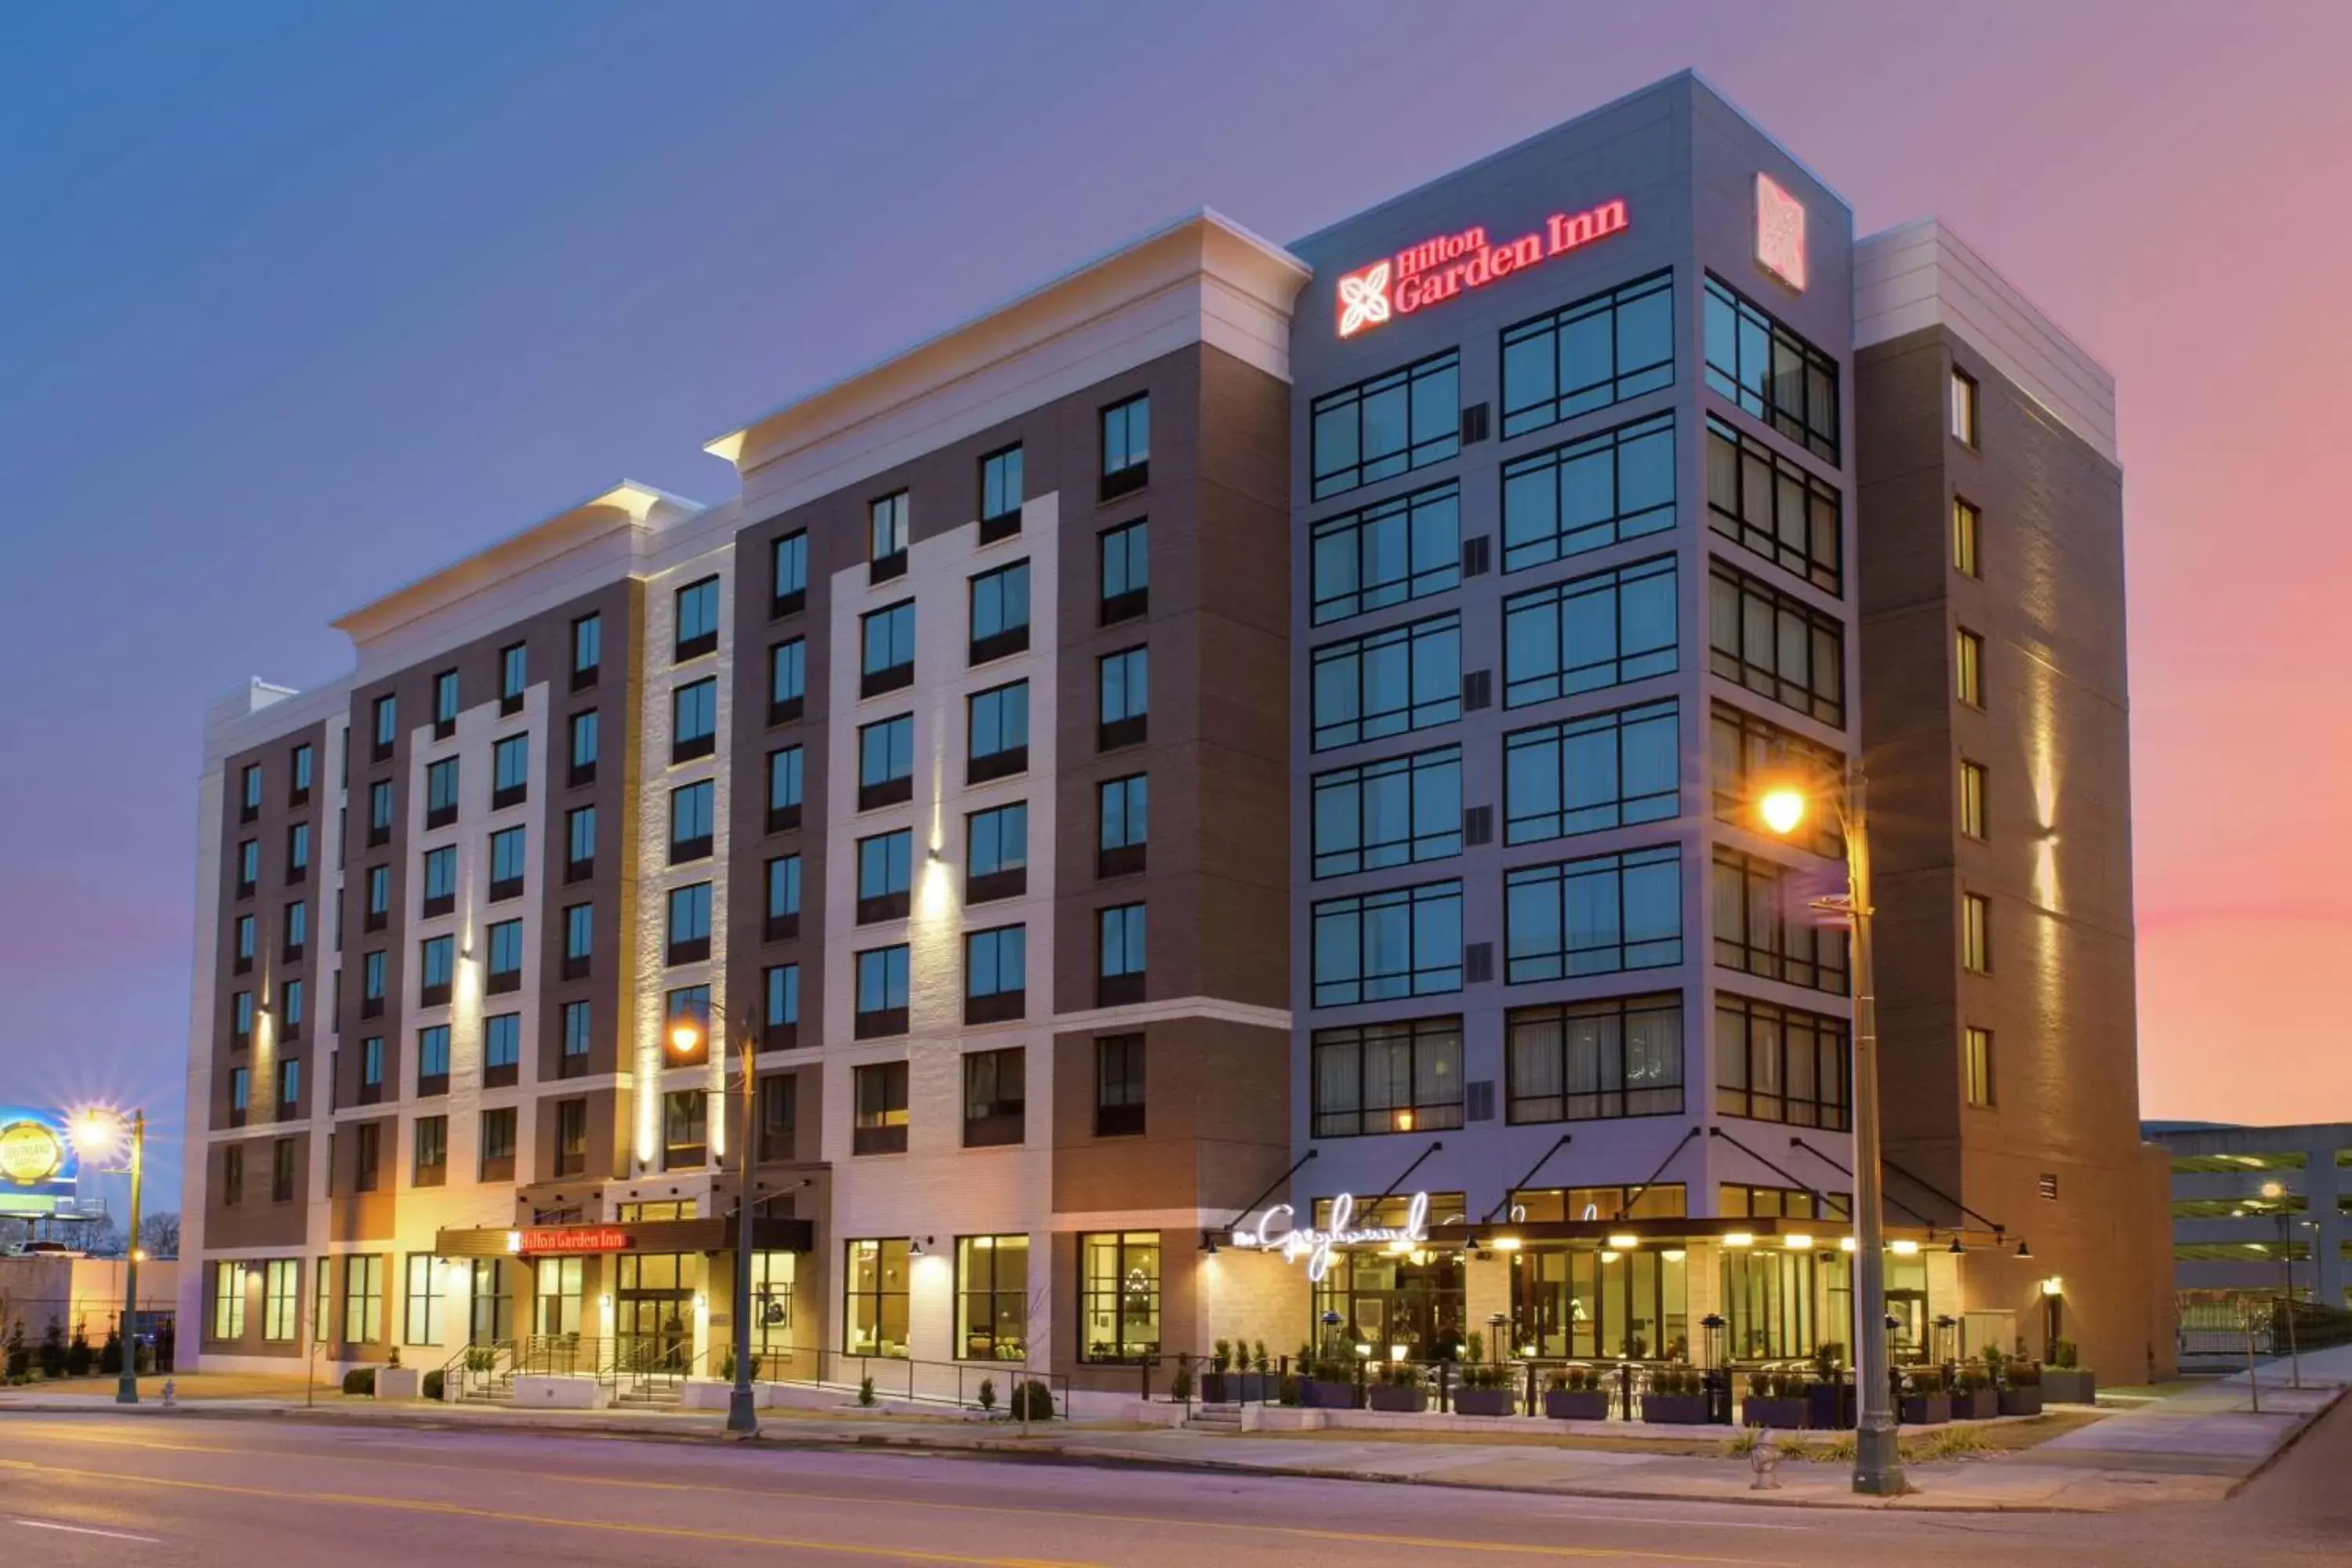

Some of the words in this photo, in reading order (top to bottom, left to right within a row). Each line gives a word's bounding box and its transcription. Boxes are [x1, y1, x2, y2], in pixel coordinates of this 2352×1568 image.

[1394, 234, 1544, 314] Garden
[1546, 198, 1629, 256] Inn
[1396, 227, 1486, 280] Hilton
[521, 1231, 556, 1249] Hilton
[557, 1231, 598, 1248] Garden
[601, 1229, 622, 1247] Inn
